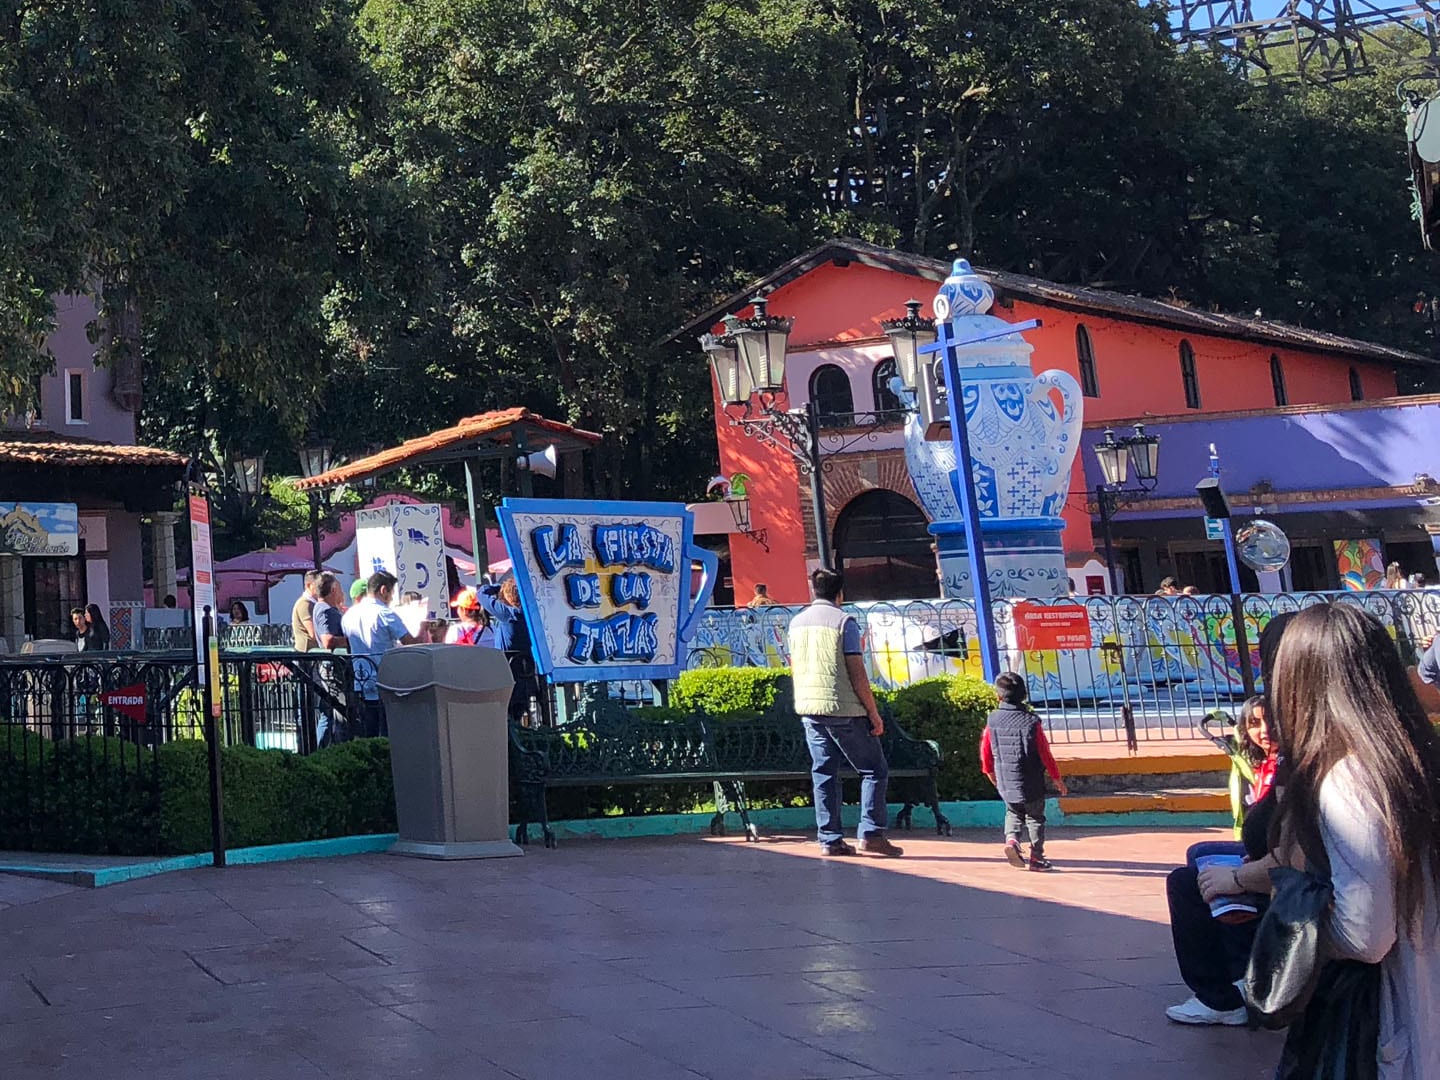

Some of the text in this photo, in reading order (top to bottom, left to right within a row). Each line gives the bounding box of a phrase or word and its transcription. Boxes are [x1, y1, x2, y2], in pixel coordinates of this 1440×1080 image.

[536, 524, 675, 575] LA FIESTA
[572, 573, 654, 607] DE LAS
[574, 615, 659, 662] TAZAS
[107, 695, 144, 705] ENTRADA
